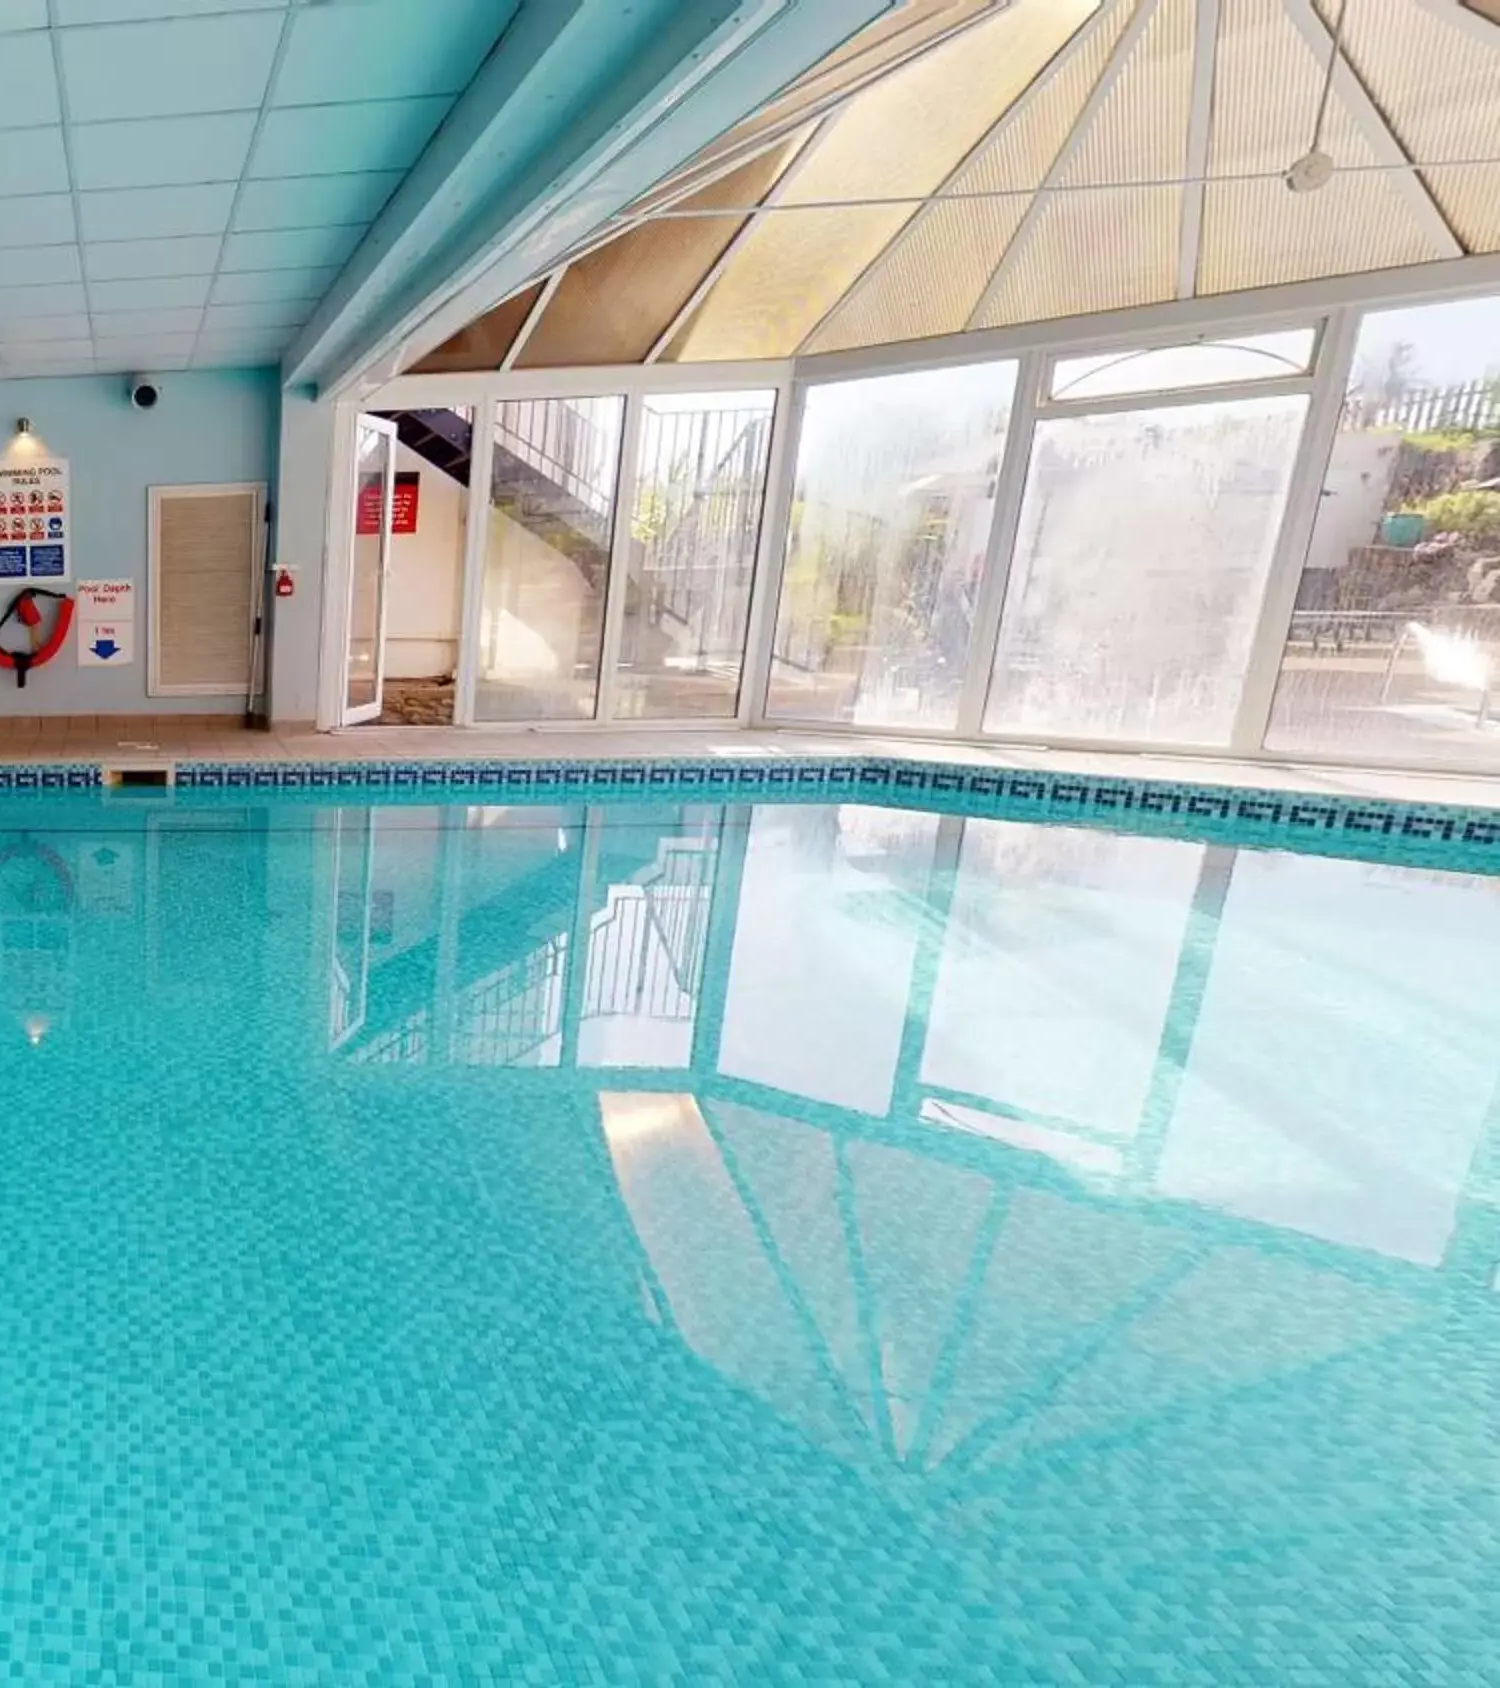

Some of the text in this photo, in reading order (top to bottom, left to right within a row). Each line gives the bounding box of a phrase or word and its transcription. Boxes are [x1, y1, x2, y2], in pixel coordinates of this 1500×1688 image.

[38, 465, 62, 476] POOL
[11, 477, 41, 486] RULES
[77, 583, 132, 594] Pool Depth
